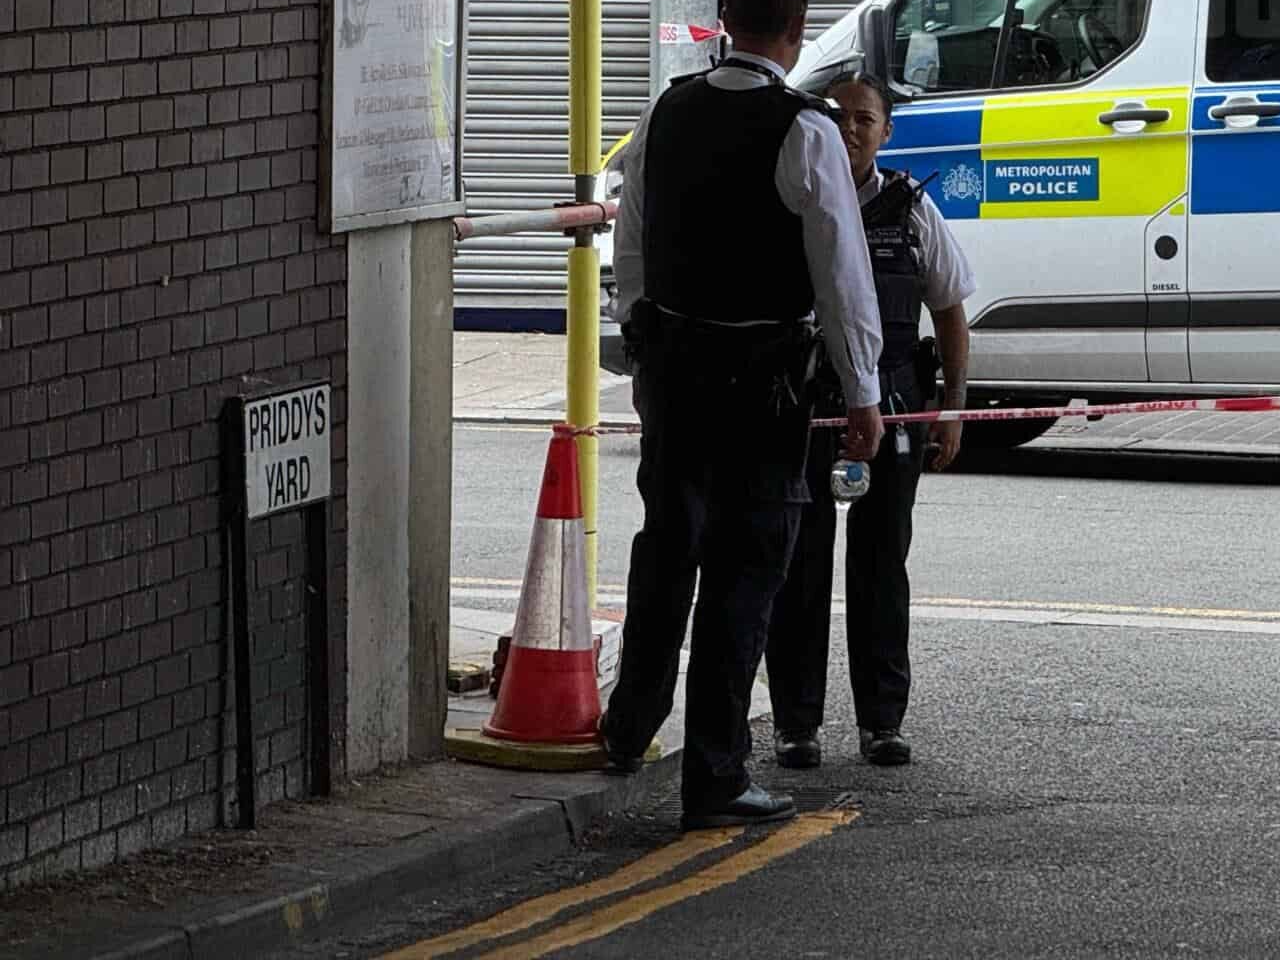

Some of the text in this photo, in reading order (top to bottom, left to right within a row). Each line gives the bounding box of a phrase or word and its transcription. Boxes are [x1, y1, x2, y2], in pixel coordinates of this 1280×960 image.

[995, 165, 1091, 178] METROPOLITAN
[1009, 181, 1079, 195] POLICE
[1152, 282, 1181, 292] DIESEL
[249, 390, 327, 453] PRIDDYS
[265, 455, 311, 509] YARD
